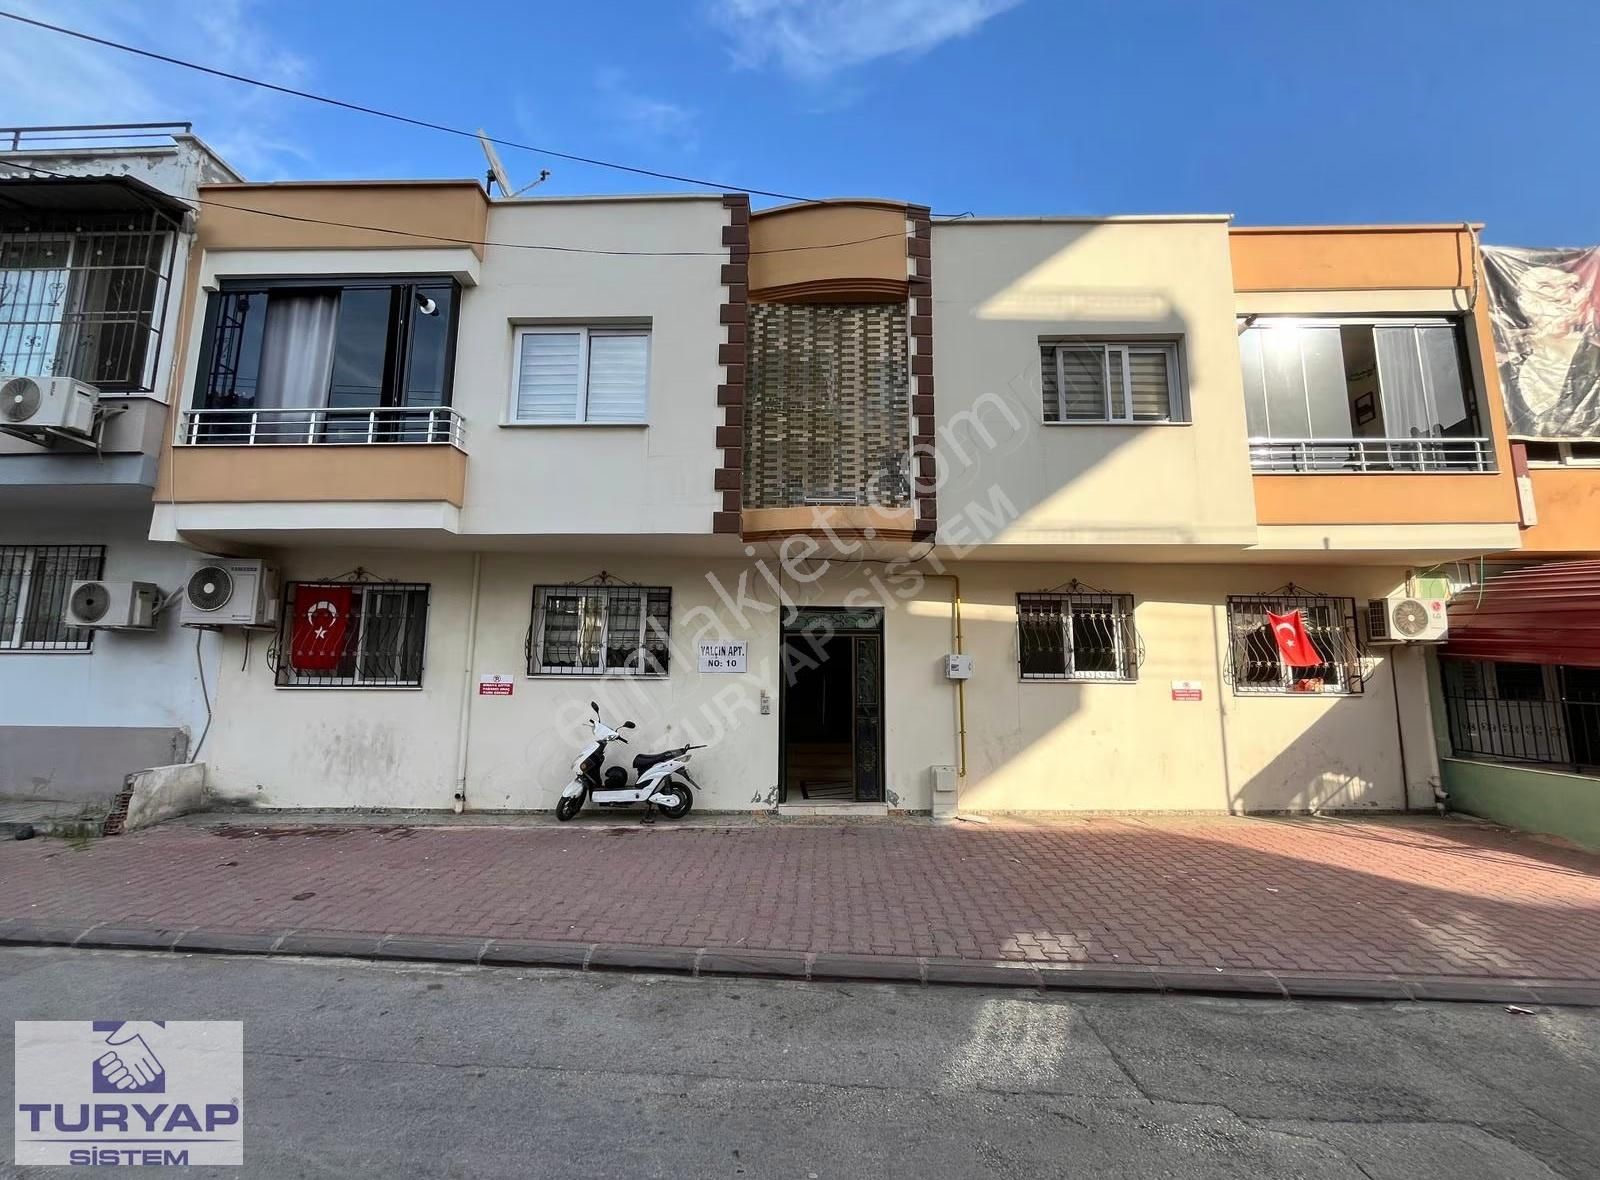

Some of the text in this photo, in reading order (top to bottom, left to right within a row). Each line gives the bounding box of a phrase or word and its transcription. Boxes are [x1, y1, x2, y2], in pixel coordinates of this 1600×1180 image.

[728, 645, 745, 656] APT.
[708, 659, 737, 667] NO: 10
